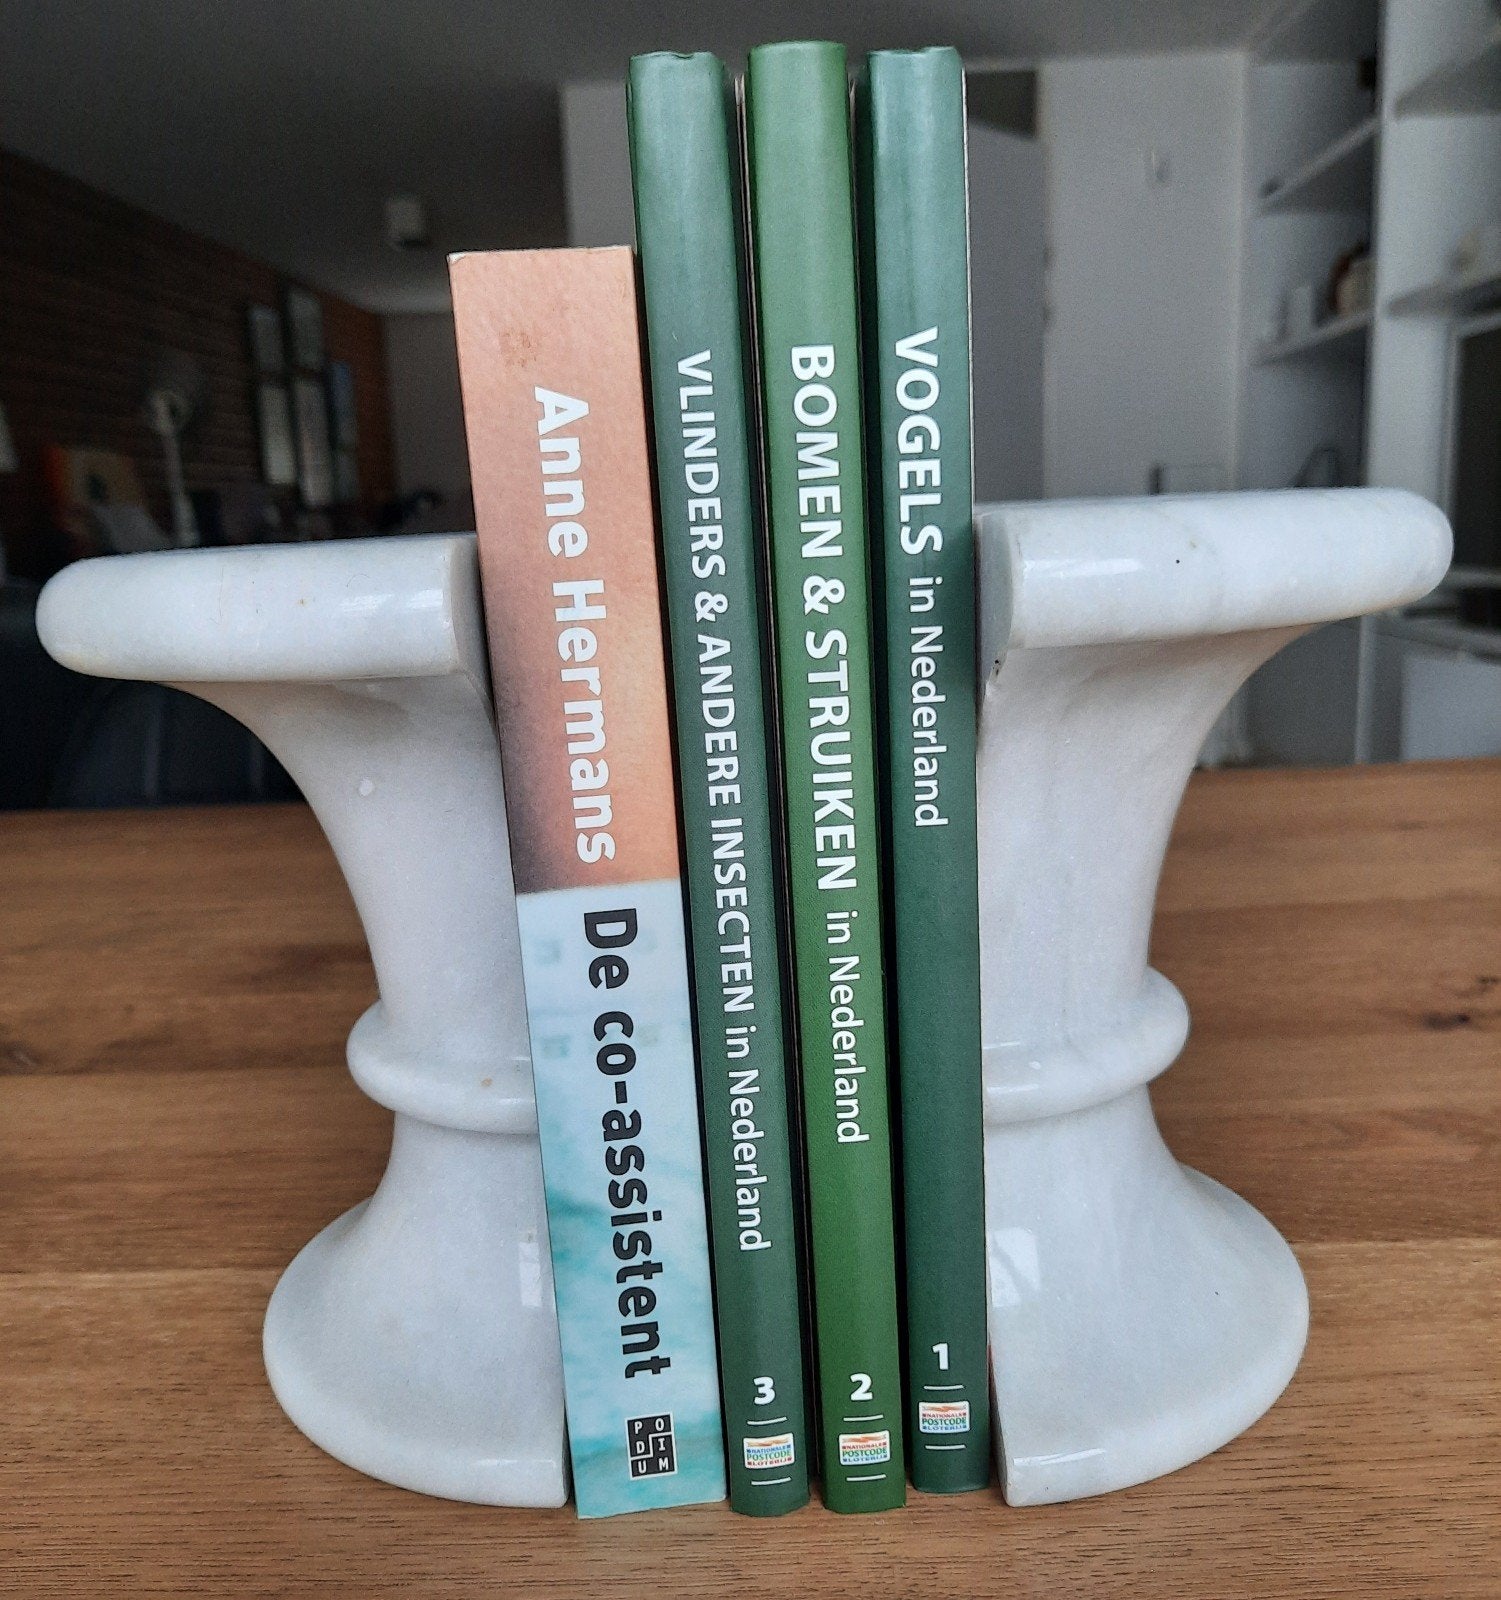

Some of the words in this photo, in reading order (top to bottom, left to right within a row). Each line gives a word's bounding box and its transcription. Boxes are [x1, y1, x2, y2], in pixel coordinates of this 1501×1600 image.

[534, 385, 590, 559] Anne
[677, 349, 726, 579] VLINDERS
[791, 344, 843, 558] BOMEN
[895, 326, 943, 555] VOGELS
[694, 591, 729, 623] &
[802, 575, 846, 616] &
[909, 576, 942, 613] in
[552, 578, 617, 865] Hermans
[697, 633, 741, 807] ANDERE
[805, 629, 857, 890] STRUIKEN
[910, 625, 949, 827] Nederland
[583, 907, 638, 990] De
[710, 817, 755, 1013] INSECTEN
[825, 910, 858, 944] in
[725, 1025, 757, 1059] in
[828, 955, 870, 1143] Nederland
[593, 1010, 671, 1379] co-assistent
[728, 1069, 772, 1251] Nederland
[753, 1376, 776, 1405] 3
[850, 1373, 873, 1401] 2
[932, 1343, 949, 1370] 1
[746, 1450, 792, 1461] POSTCODE
[842, 1447, 887, 1457] POSTCODE
[922, 1417, 967, 1425] POSTCODE
